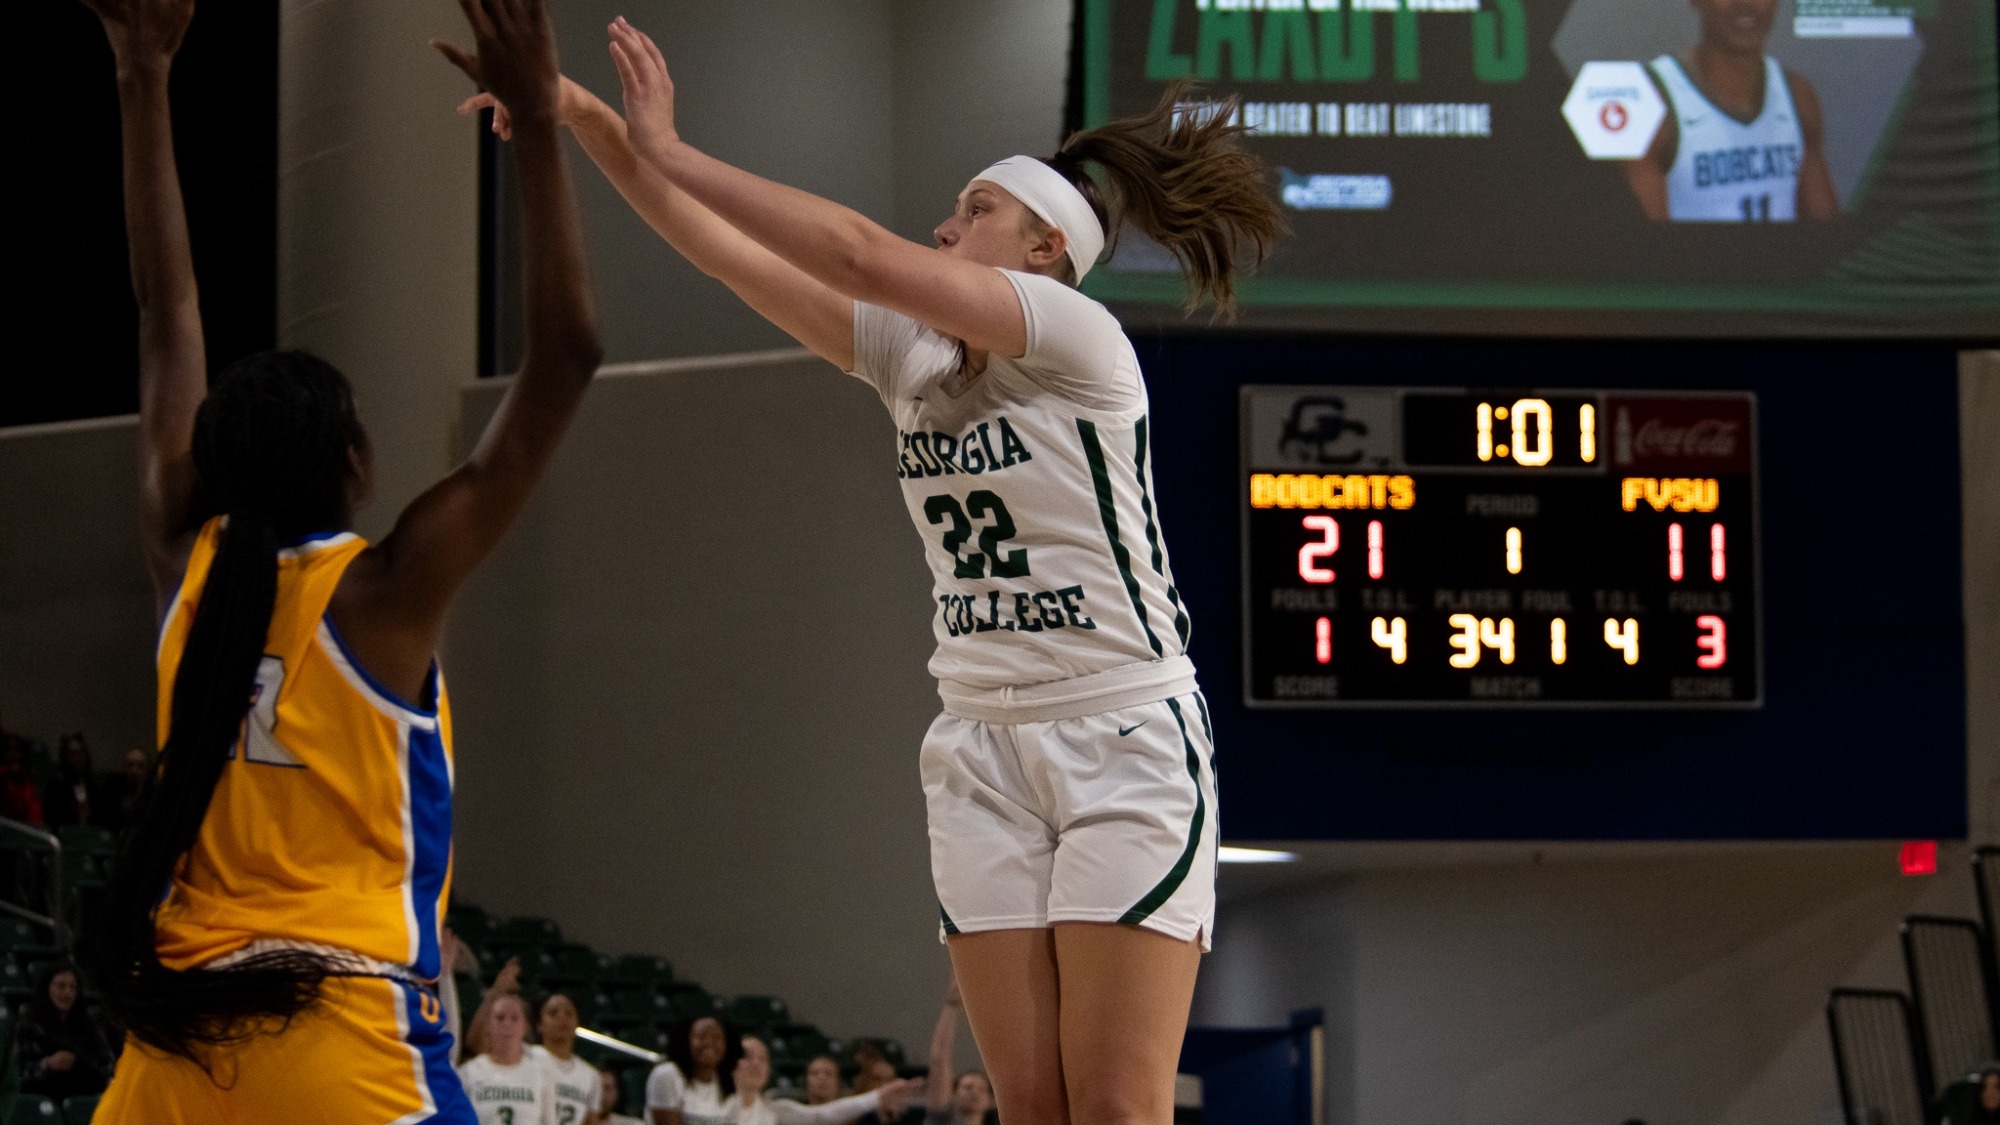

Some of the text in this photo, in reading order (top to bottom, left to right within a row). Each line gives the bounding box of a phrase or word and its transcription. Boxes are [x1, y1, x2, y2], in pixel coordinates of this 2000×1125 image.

[1316, 102, 1341, 136] TO
[1694, 144, 1800, 188] BOBCATS
[1477, 398, 1596, 466] 1:01
[1250, 474, 1416, 510] BOBCATS
[1466, 494, 1539, 517] PERIOD
[1622, 477, 1719, 512] FVSU
[924, 489, 1031, 580] 22
[1505, 526, 1522, 574] 1
[1668, 522, 1726, 582] 11
[1271, 588, 1338, 610] FOULS
[1434, 589, 1512, 611] PLAYER
[1316, 616, 1331, 664] 1
[1371, 616, 1407, 664] 4
[1449, 613, 1515, 668] 34
[1550, 617, 1567, 665] 1
[1603, 617, 1639, 665] 4
[1697, 615, 1727, 669] 3
[1274, 675, 1338, 697] SCORE
[1470, 676, 1541, 699] MATCH
